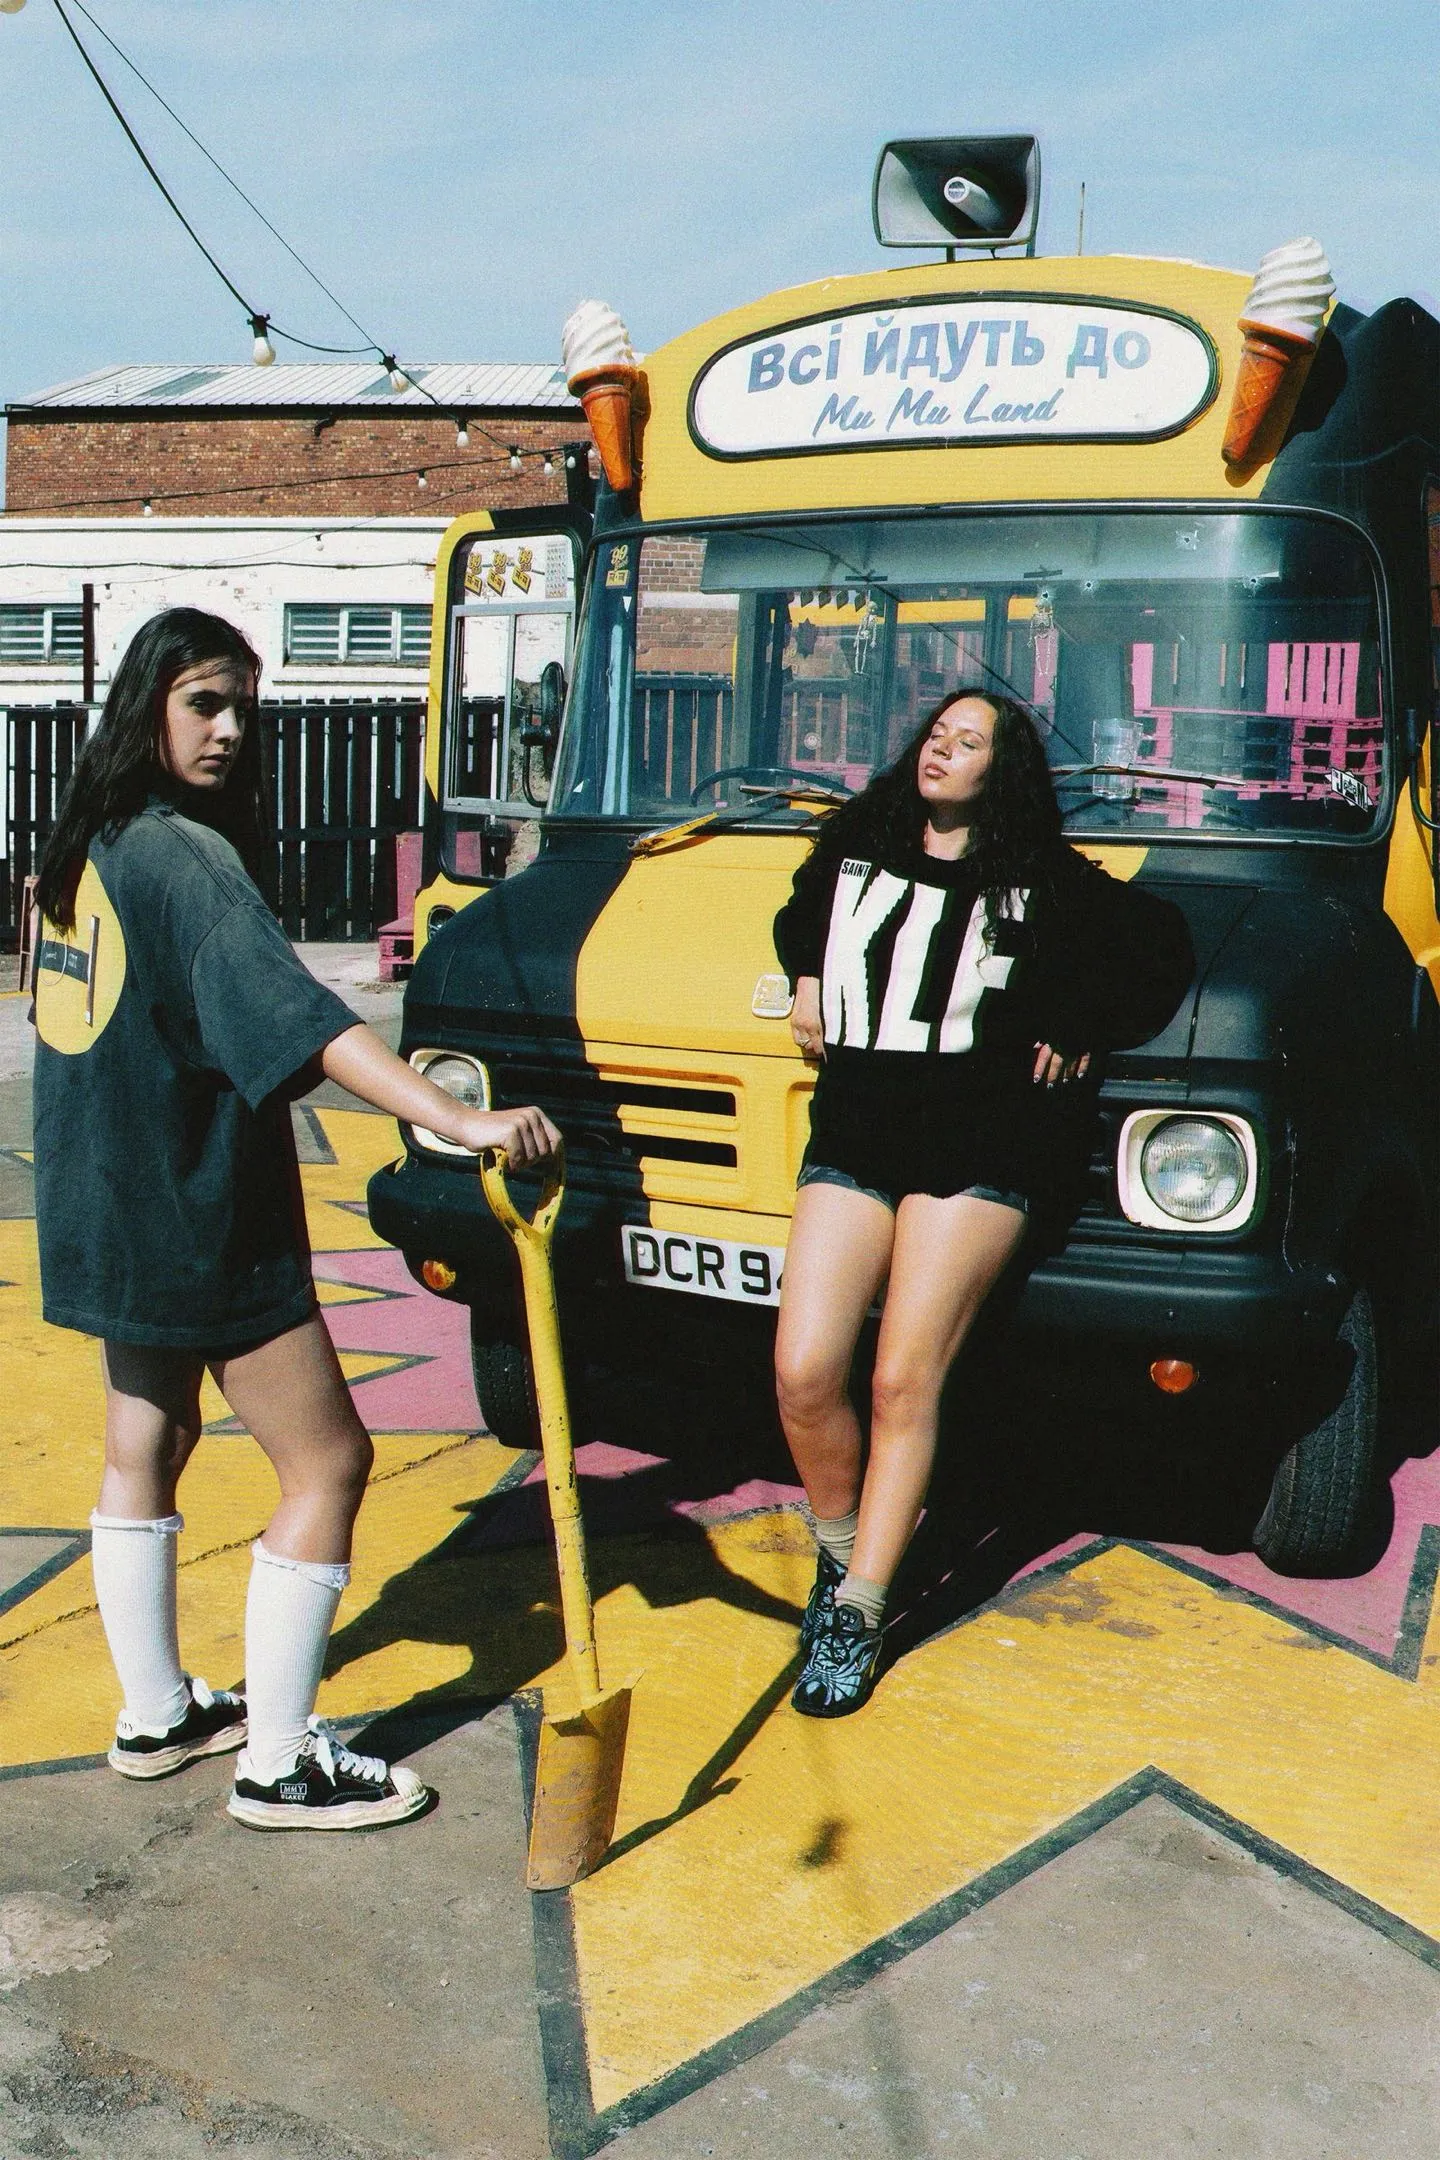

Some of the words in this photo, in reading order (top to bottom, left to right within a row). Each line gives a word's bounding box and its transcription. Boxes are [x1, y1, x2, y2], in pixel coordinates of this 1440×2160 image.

[748, 323, 843, 393] Всі
[863, 315, 1046, 382] йдуть
[1066, 324, 1151, 379] до
[812, 392, 876, 437] Mu
[886, 387, 952, 432] Mu
[963, 383, 1065, 425] Land
[841, 861, 871, 878] SAINT
[822, 857, 1031, 1054] KLF
[629, 1231, 727, 1290] DCR
[283, 1784, 304, 1793] MMY
